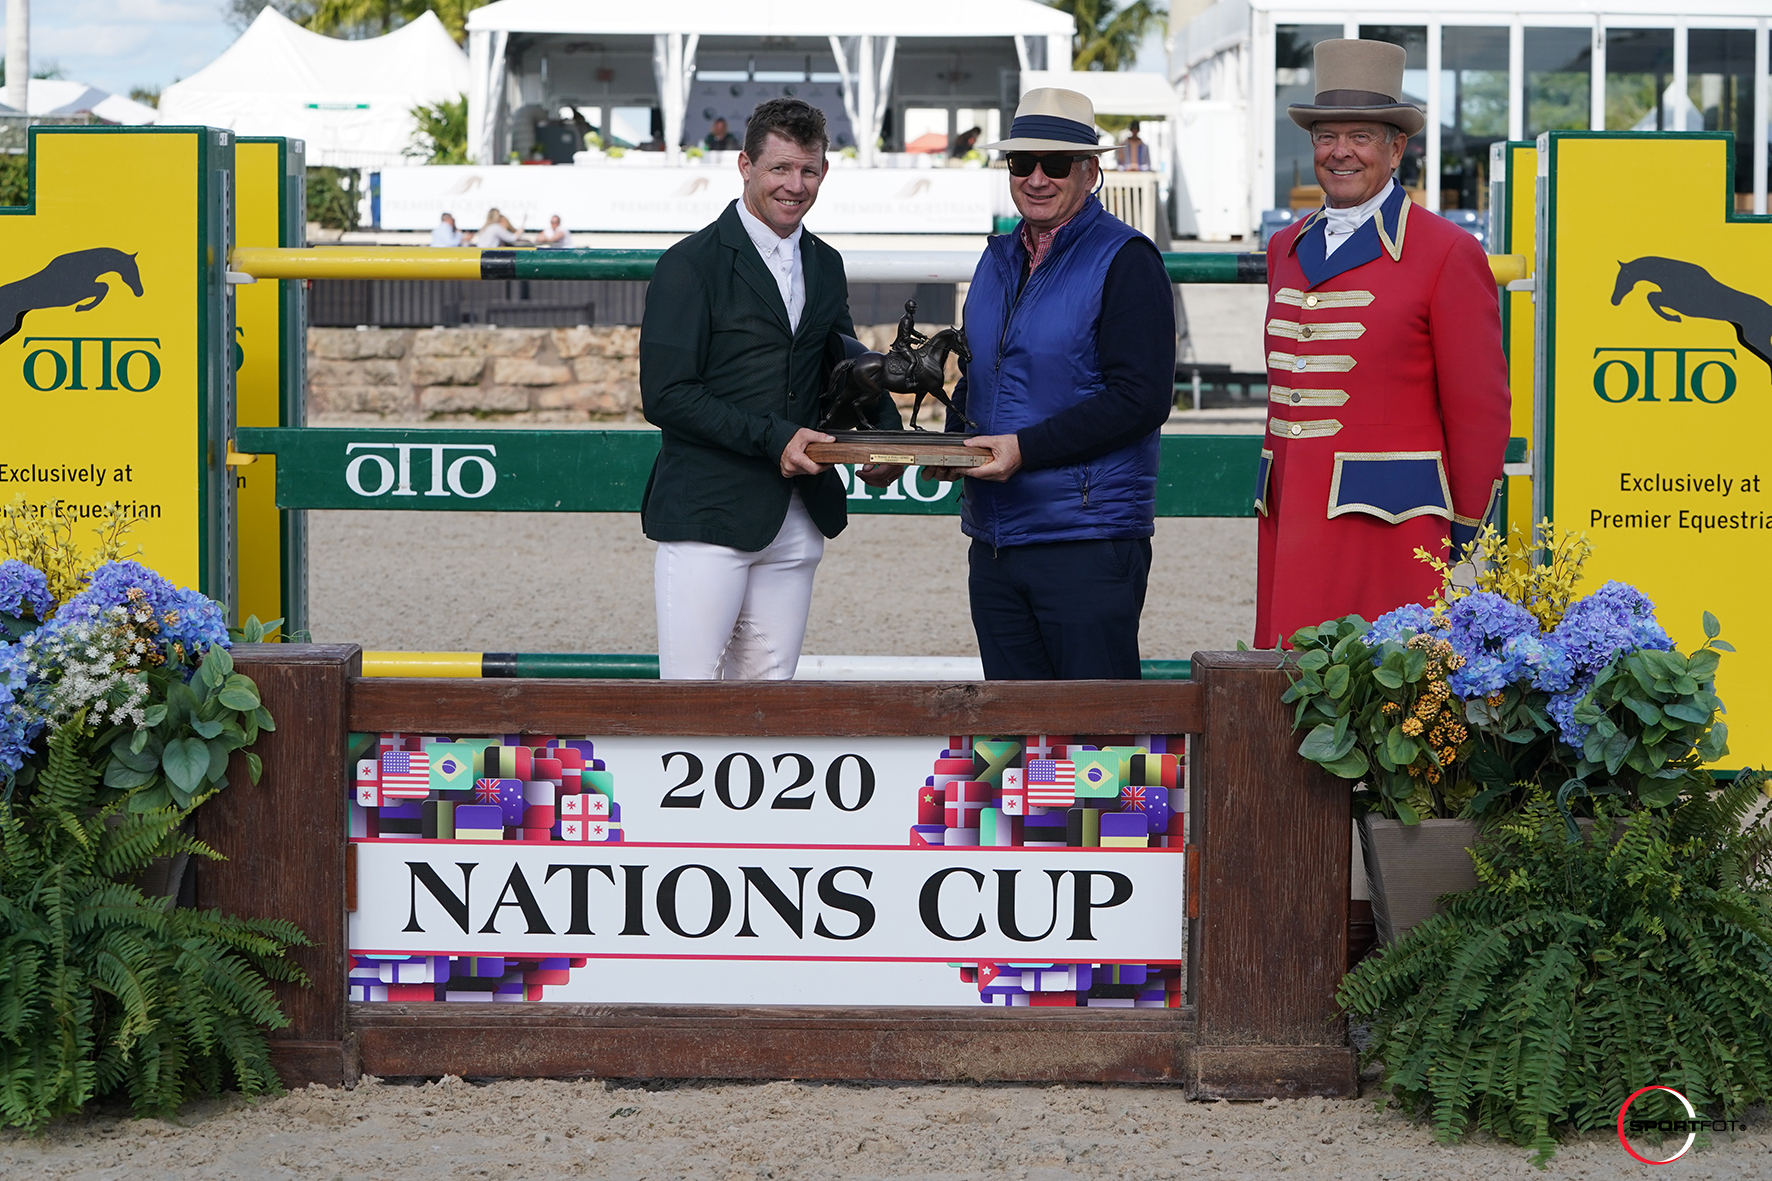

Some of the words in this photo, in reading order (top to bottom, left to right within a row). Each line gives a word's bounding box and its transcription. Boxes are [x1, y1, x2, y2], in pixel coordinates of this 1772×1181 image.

[23, 337, 161, 392] OTTO
[1593, 347, 1737, 404] OTTO
[0, 464, 106, 486] Exclusively
[113, 464, 133, 482] at
[346, 443, 497, 498] OTTO
[1620, 473, 1733, 497] Exclusively
[1740, 475, 1761, 493] at
[1590, 509, 1671, 529] Premier
[660, 751, 876, 812] 2020
[401, 861, 876, 941] NATIONS
[918, 867, 1134, 942] CUP
